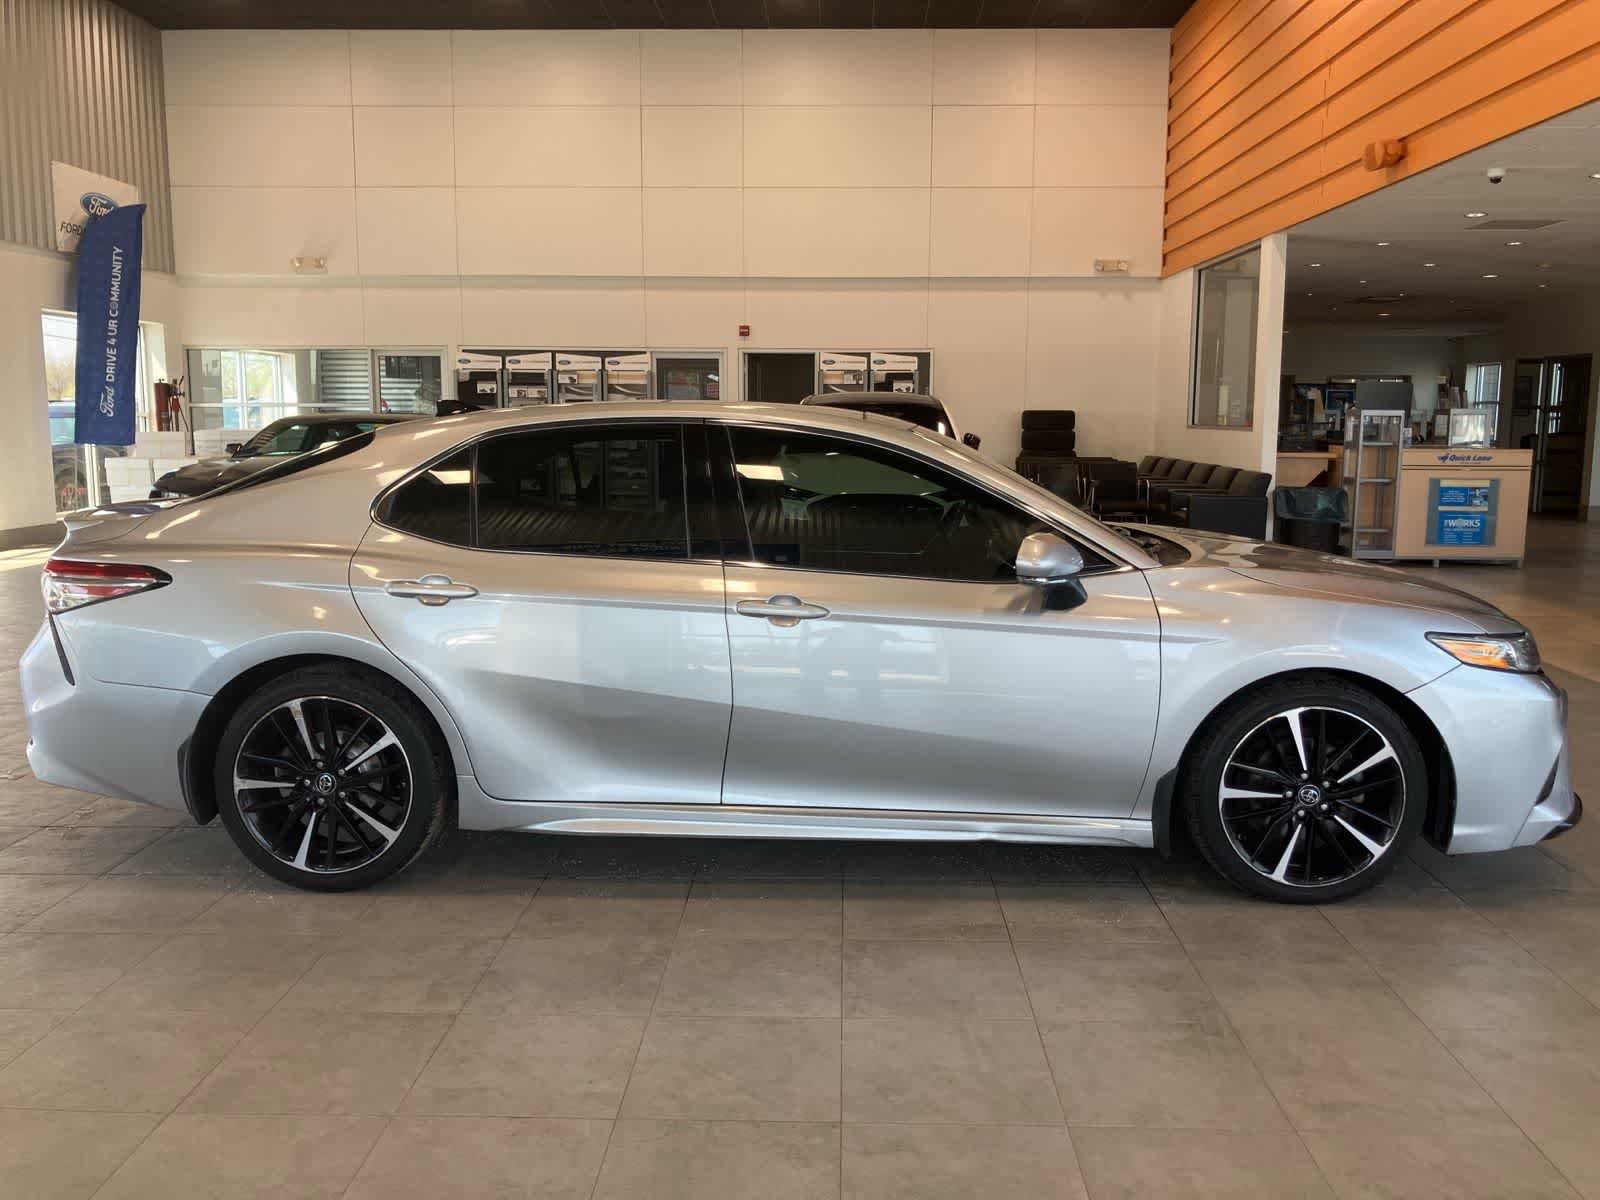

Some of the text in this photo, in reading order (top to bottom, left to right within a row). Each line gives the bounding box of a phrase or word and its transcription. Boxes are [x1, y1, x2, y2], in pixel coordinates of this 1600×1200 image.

[109, 246, 123, 317] COMMUNITY
[107, 319, 118, 336] UR
[106, 348, 117, 382] DRIVE
[100, 386, 114, 417] Ford
